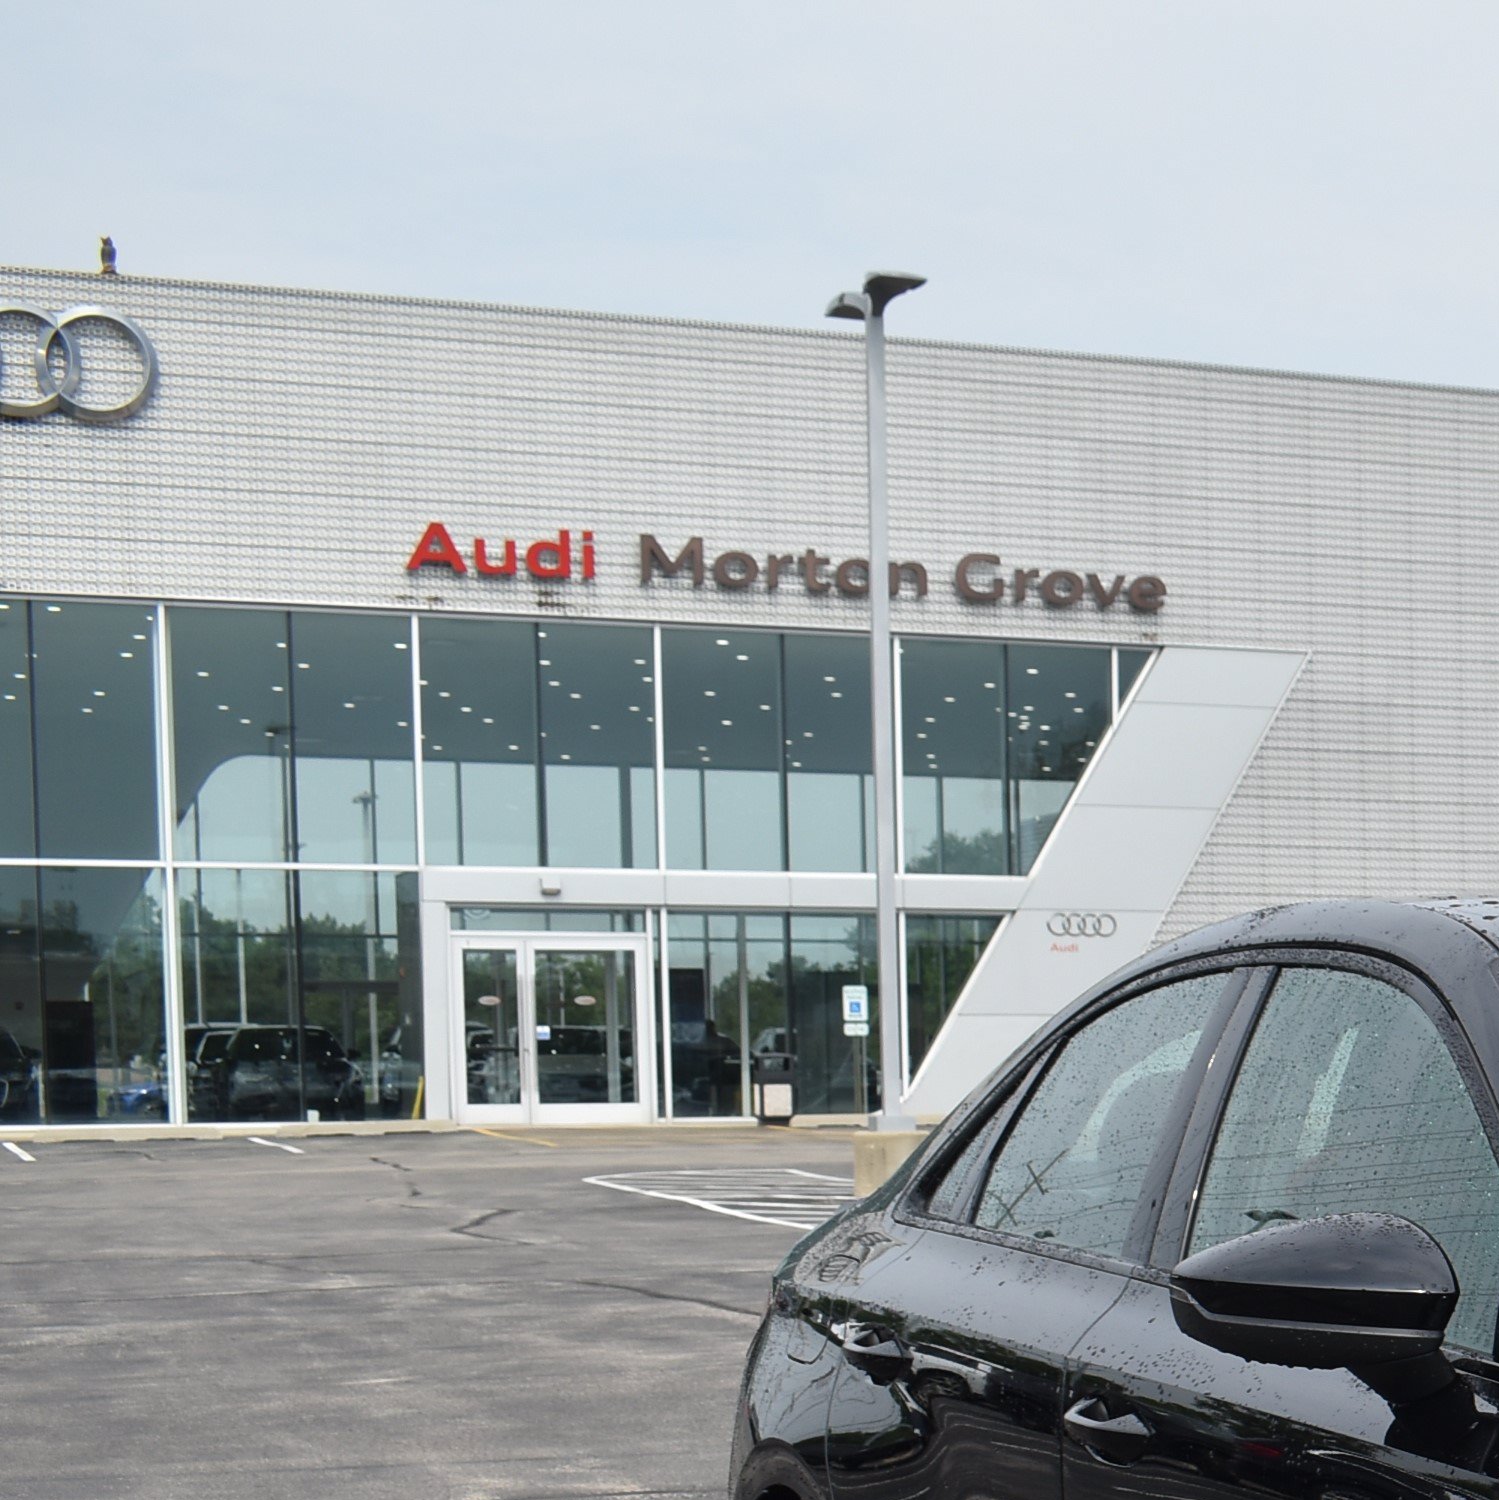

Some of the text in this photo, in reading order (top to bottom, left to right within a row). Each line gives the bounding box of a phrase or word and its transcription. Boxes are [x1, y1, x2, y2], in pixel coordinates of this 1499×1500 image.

[407, 522, 1168, 612] Audi Morton Grove
[1050, 943, 1079, 953] Audi
